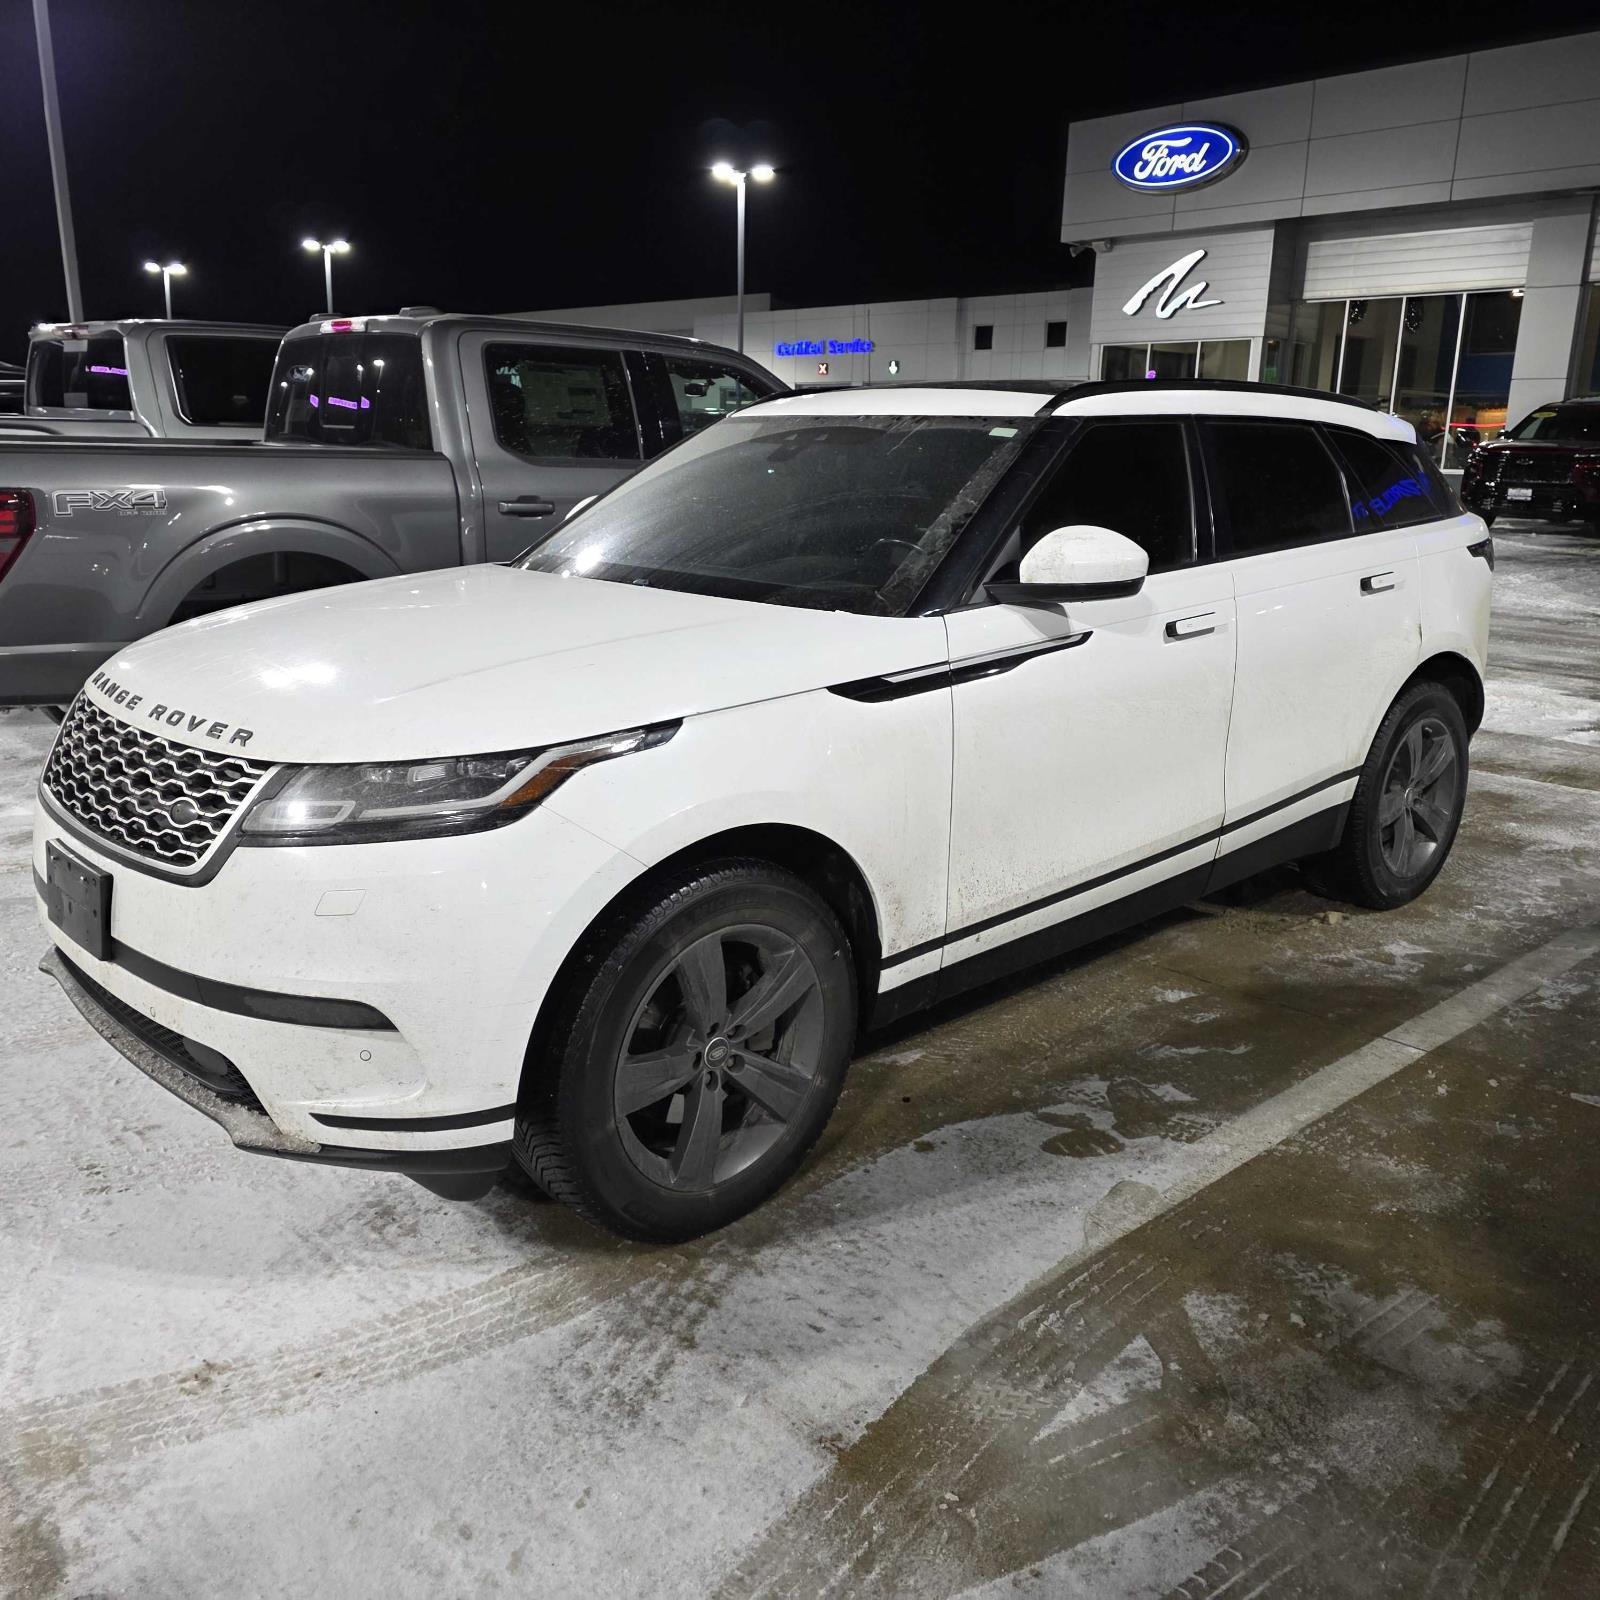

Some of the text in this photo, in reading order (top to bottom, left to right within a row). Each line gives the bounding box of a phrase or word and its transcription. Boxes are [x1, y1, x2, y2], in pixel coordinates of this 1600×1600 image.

[1133, 137, 1211, 180] Ford
[828, 338, 875, 354] Service
[51, 489, 167, 517] FX4
[93, 672, 255, 747] RANGE ROVER
